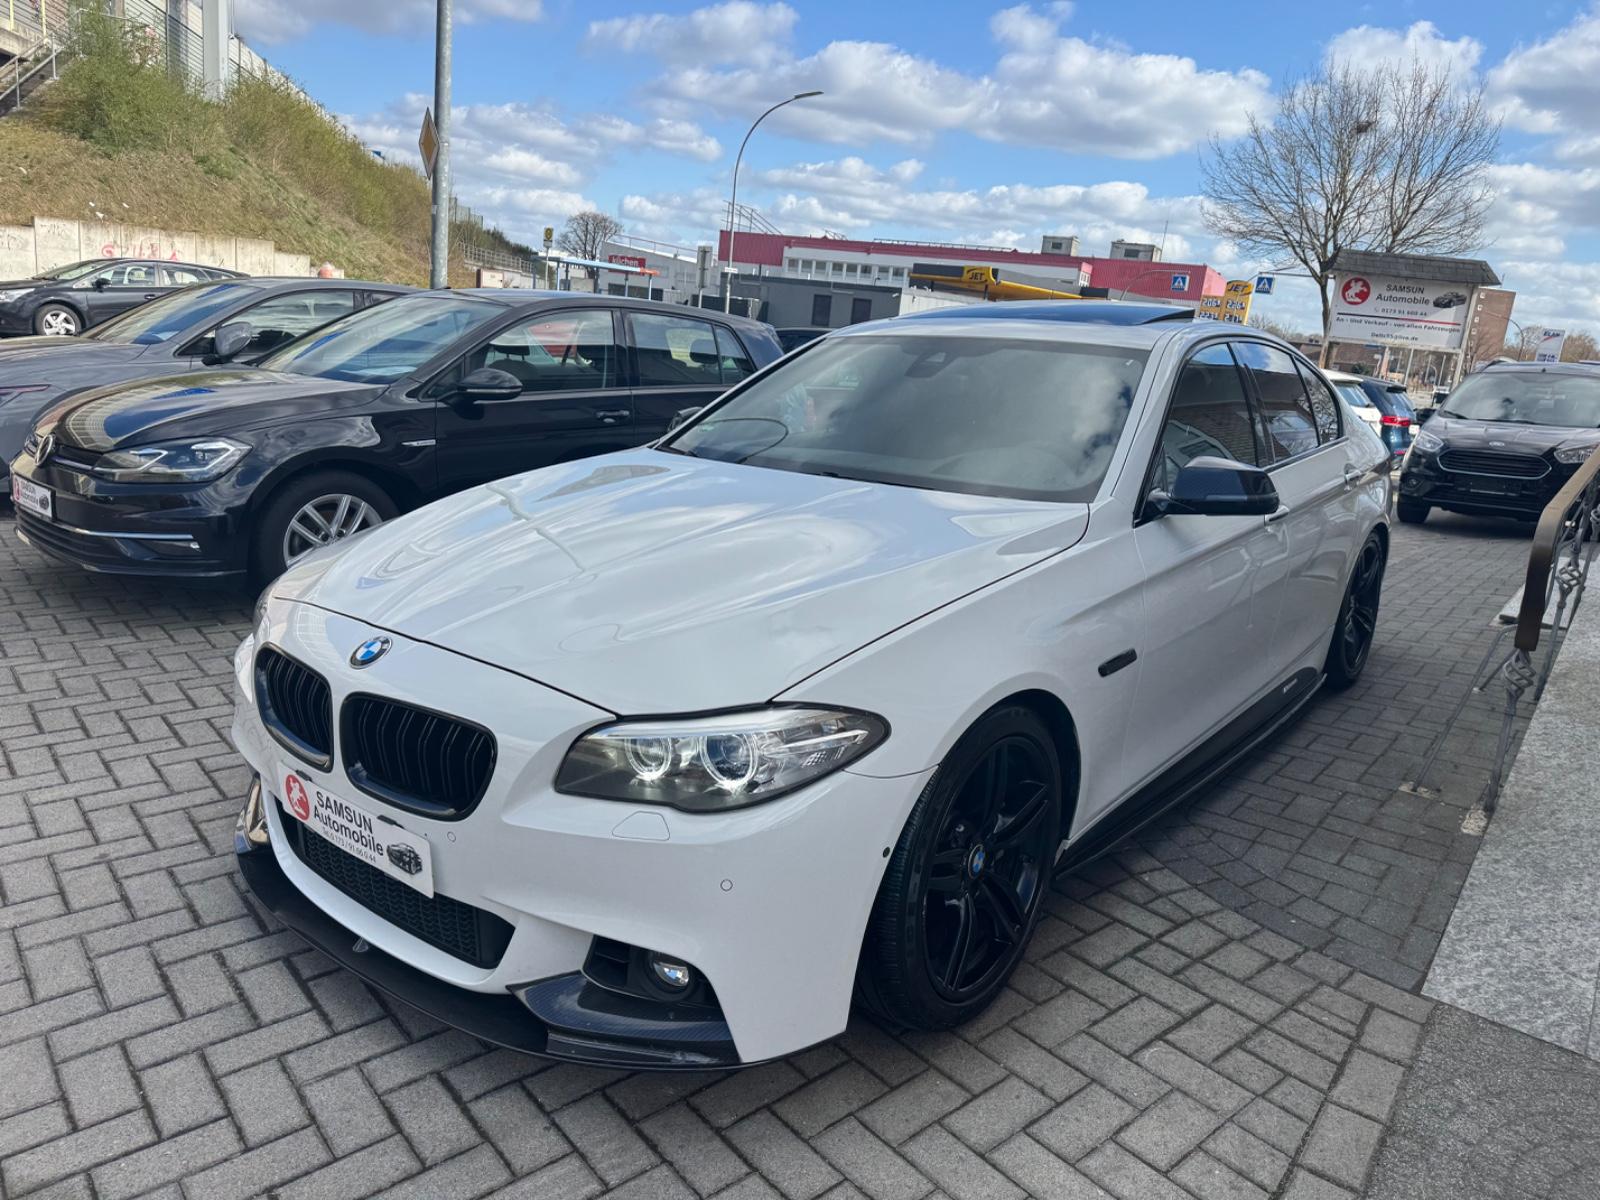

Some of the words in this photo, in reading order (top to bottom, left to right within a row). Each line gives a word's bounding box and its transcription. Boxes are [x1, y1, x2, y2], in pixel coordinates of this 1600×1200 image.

[969, 271, 985, 281] JET
[1228, 284, 1248, 292] JET
[1386, 283, 1425, 295] SAMSUN
[1376, 293, 1430, 305] Automobile
[316, 791, 373, 834] SAMSUN
[314, 805, 384, 856] Automobile
